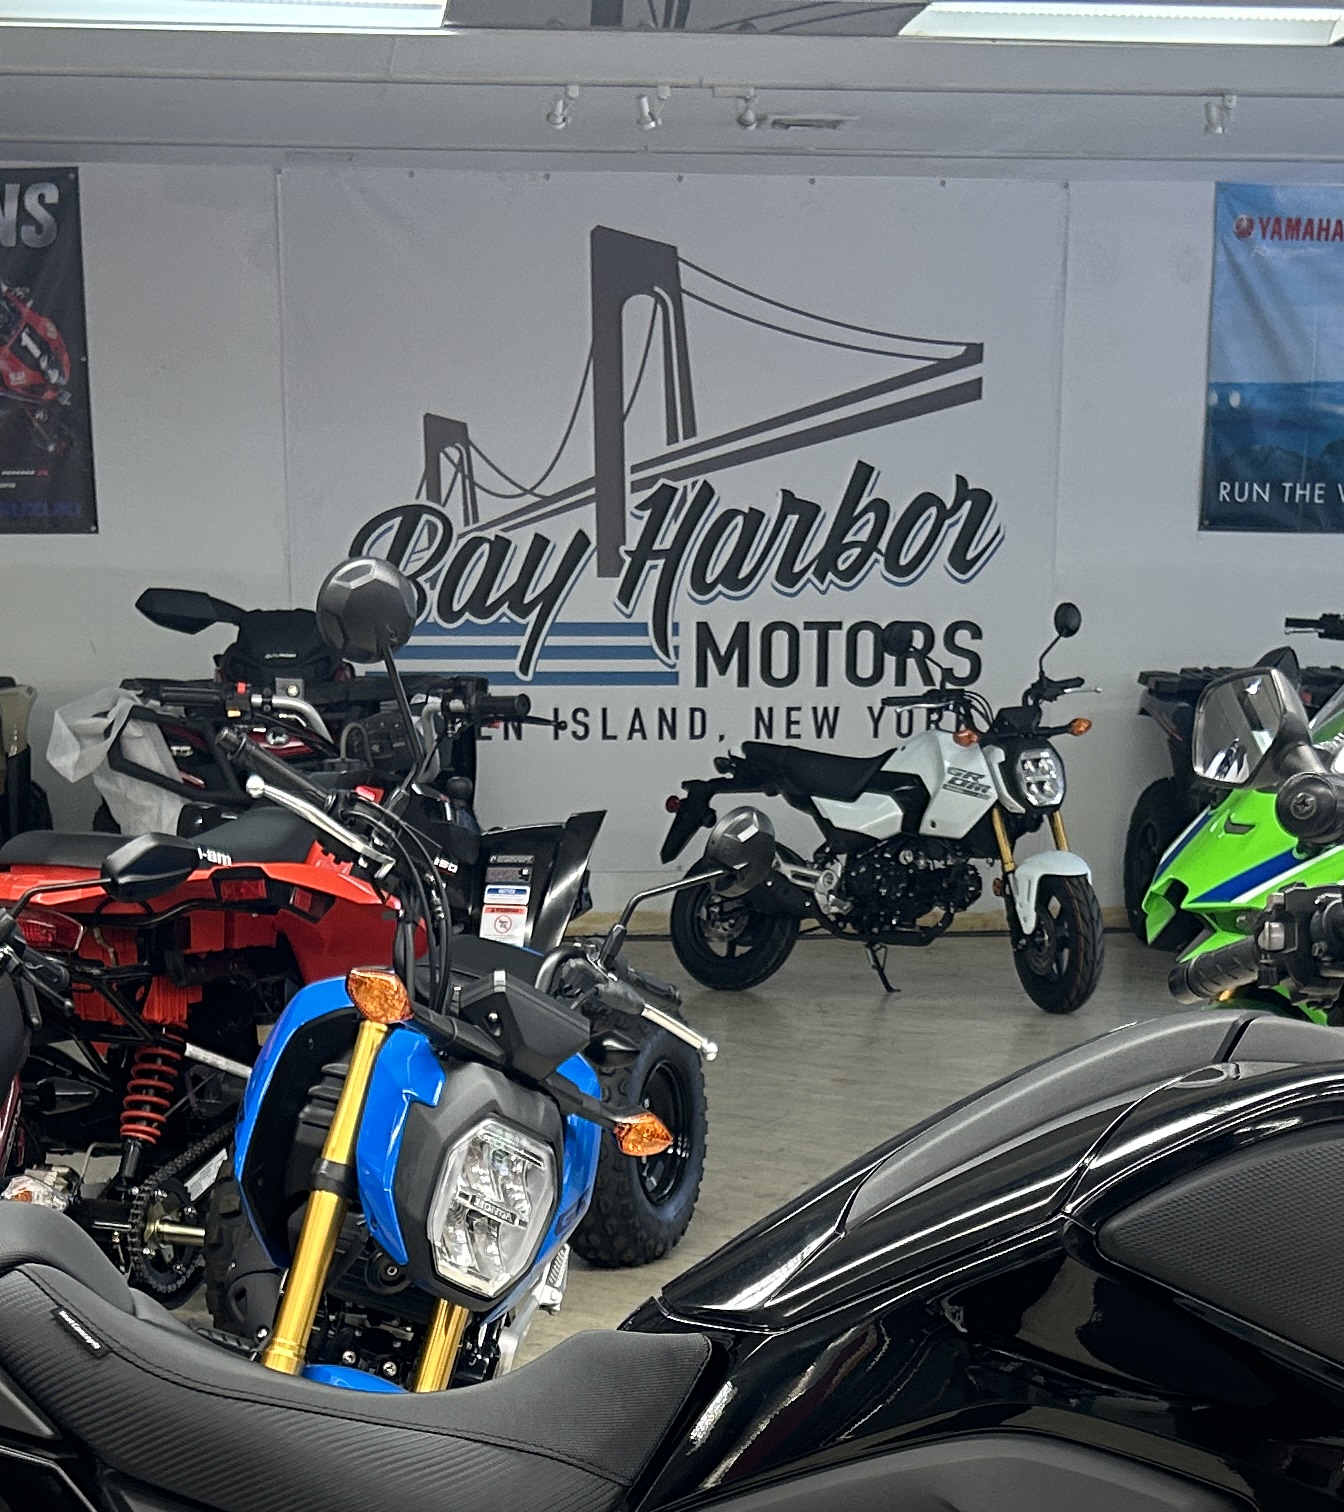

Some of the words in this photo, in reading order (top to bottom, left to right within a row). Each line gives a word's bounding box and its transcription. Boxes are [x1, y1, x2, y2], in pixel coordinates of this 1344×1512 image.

[1258, 216, 1344, 242] YAMAHA
[1219, 481, 1271, 503] RUN
[1282, 482, 1326, 504] THE
[348, 503, 593, 681] Bay
[614, 460, 1002, 663] Harbor
[695, 619, 984, 688] MOTORS
[552, 706, 726, 743] ISLAND,
[754, 705, 840, 740] NEW
[866, 705, 978, 739] YOR
